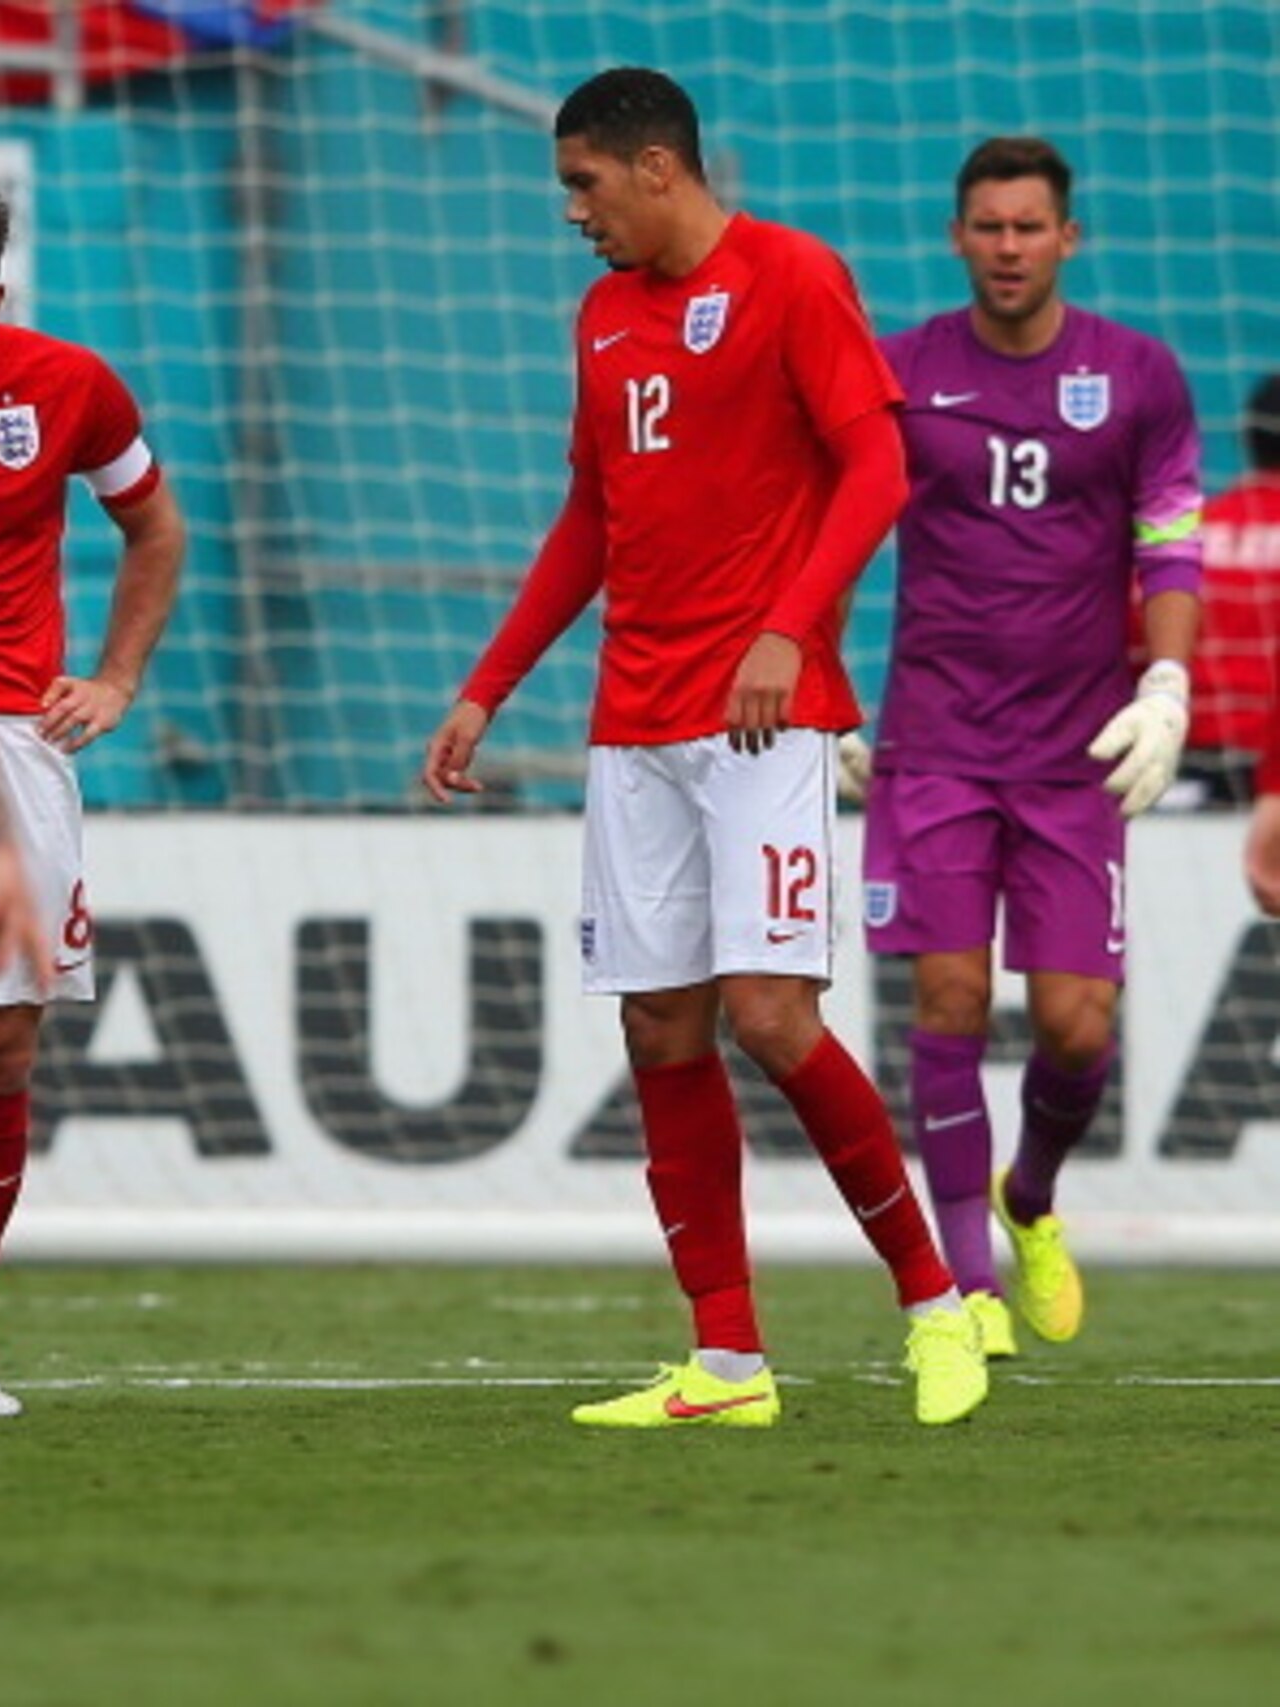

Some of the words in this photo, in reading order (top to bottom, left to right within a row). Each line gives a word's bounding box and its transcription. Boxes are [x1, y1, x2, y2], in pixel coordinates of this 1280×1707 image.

[626, 373, 670, 453] 12
[987, 436, 1048, 509] 13
[762, 844, 816, 922] 12
